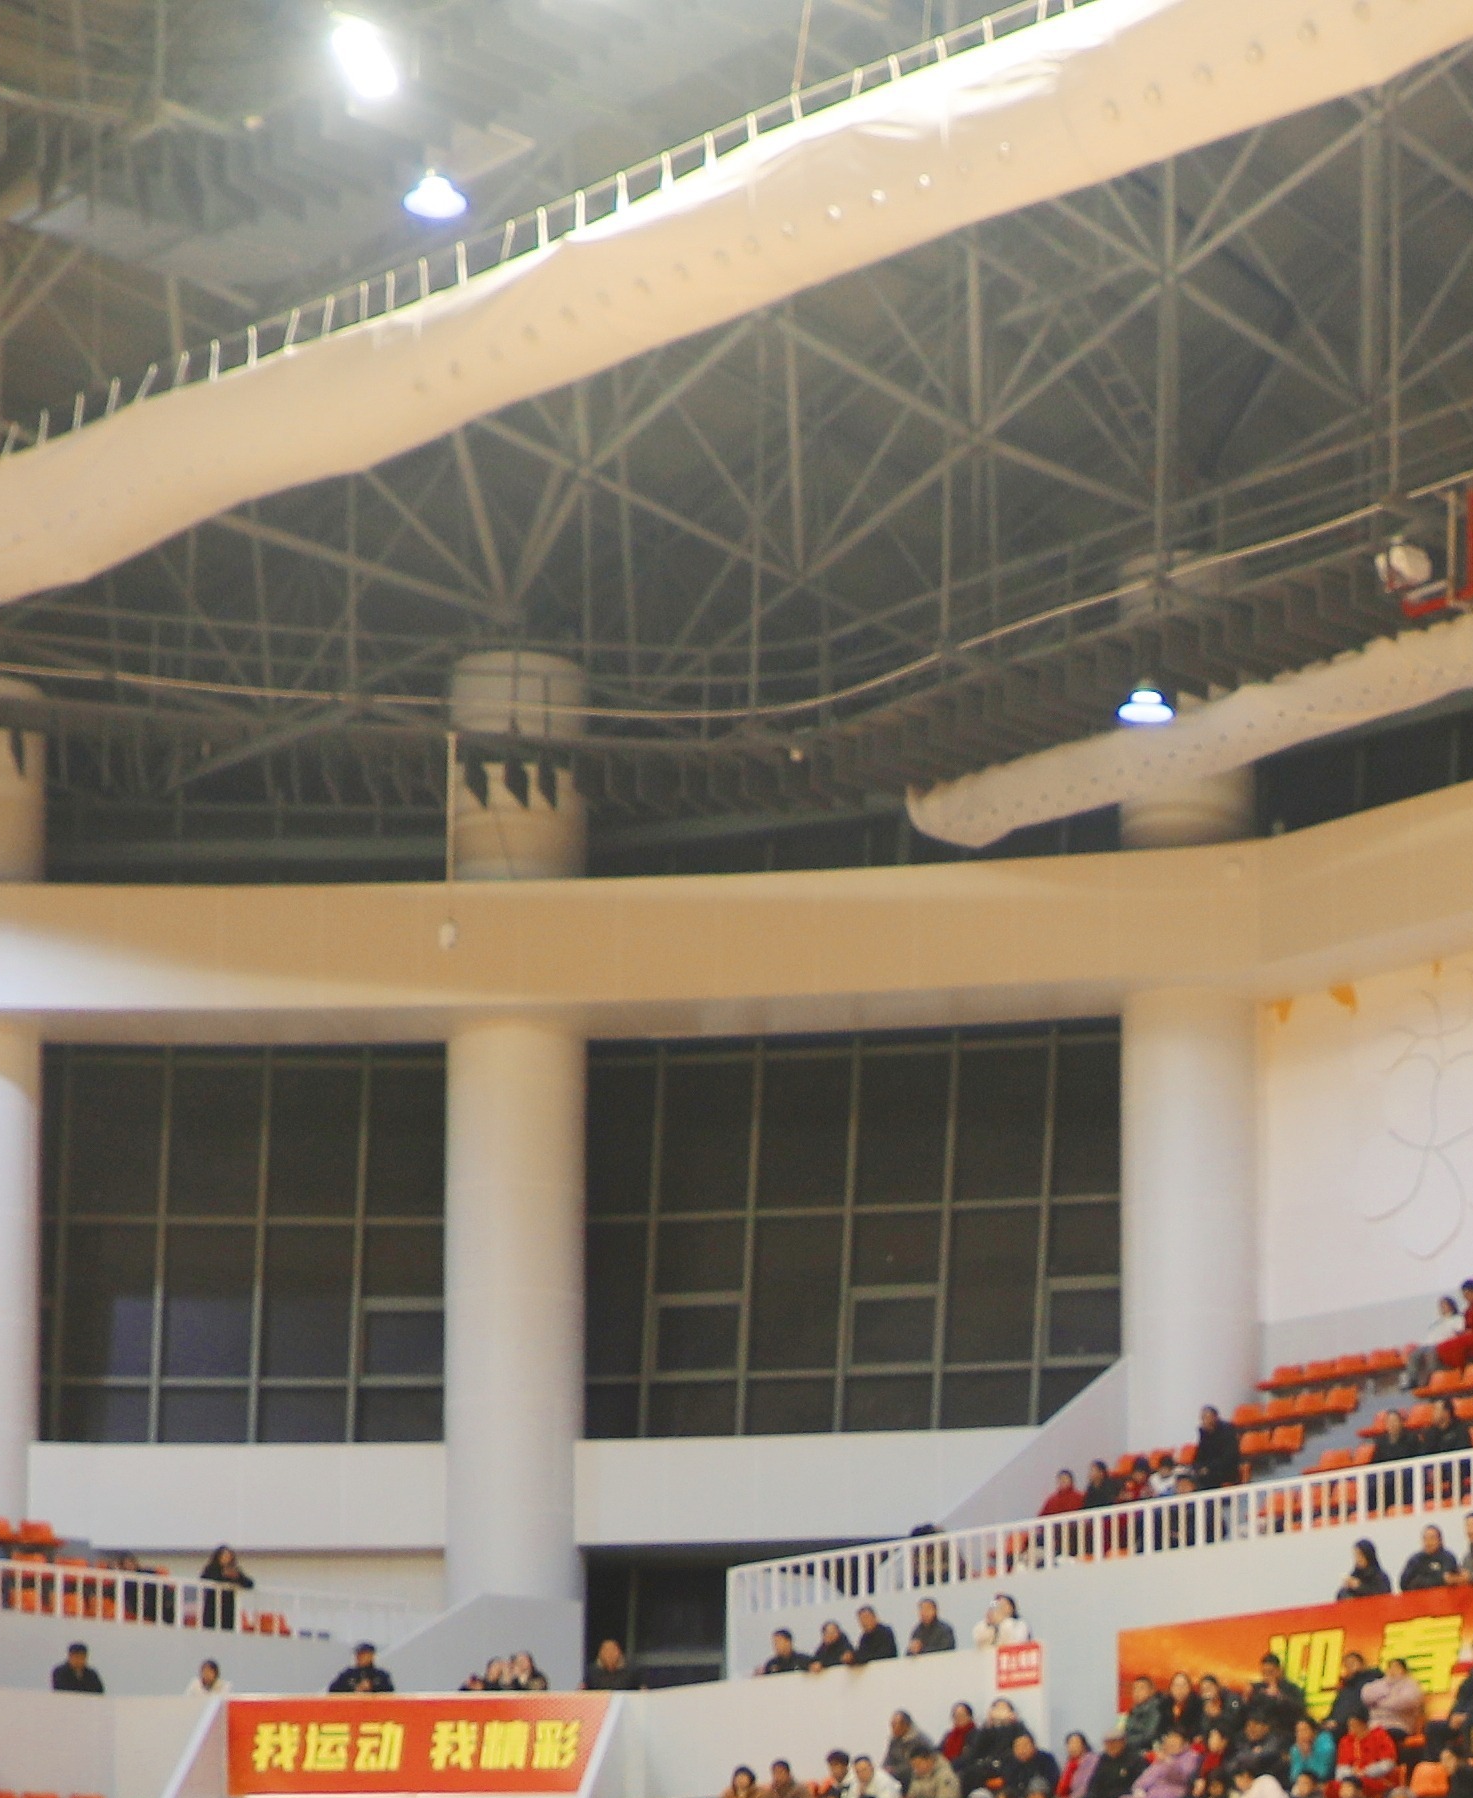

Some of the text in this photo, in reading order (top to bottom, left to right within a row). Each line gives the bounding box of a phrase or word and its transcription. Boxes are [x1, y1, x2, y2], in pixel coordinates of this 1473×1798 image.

[250, 1719, 583, 1773] 我运动 我精彩
